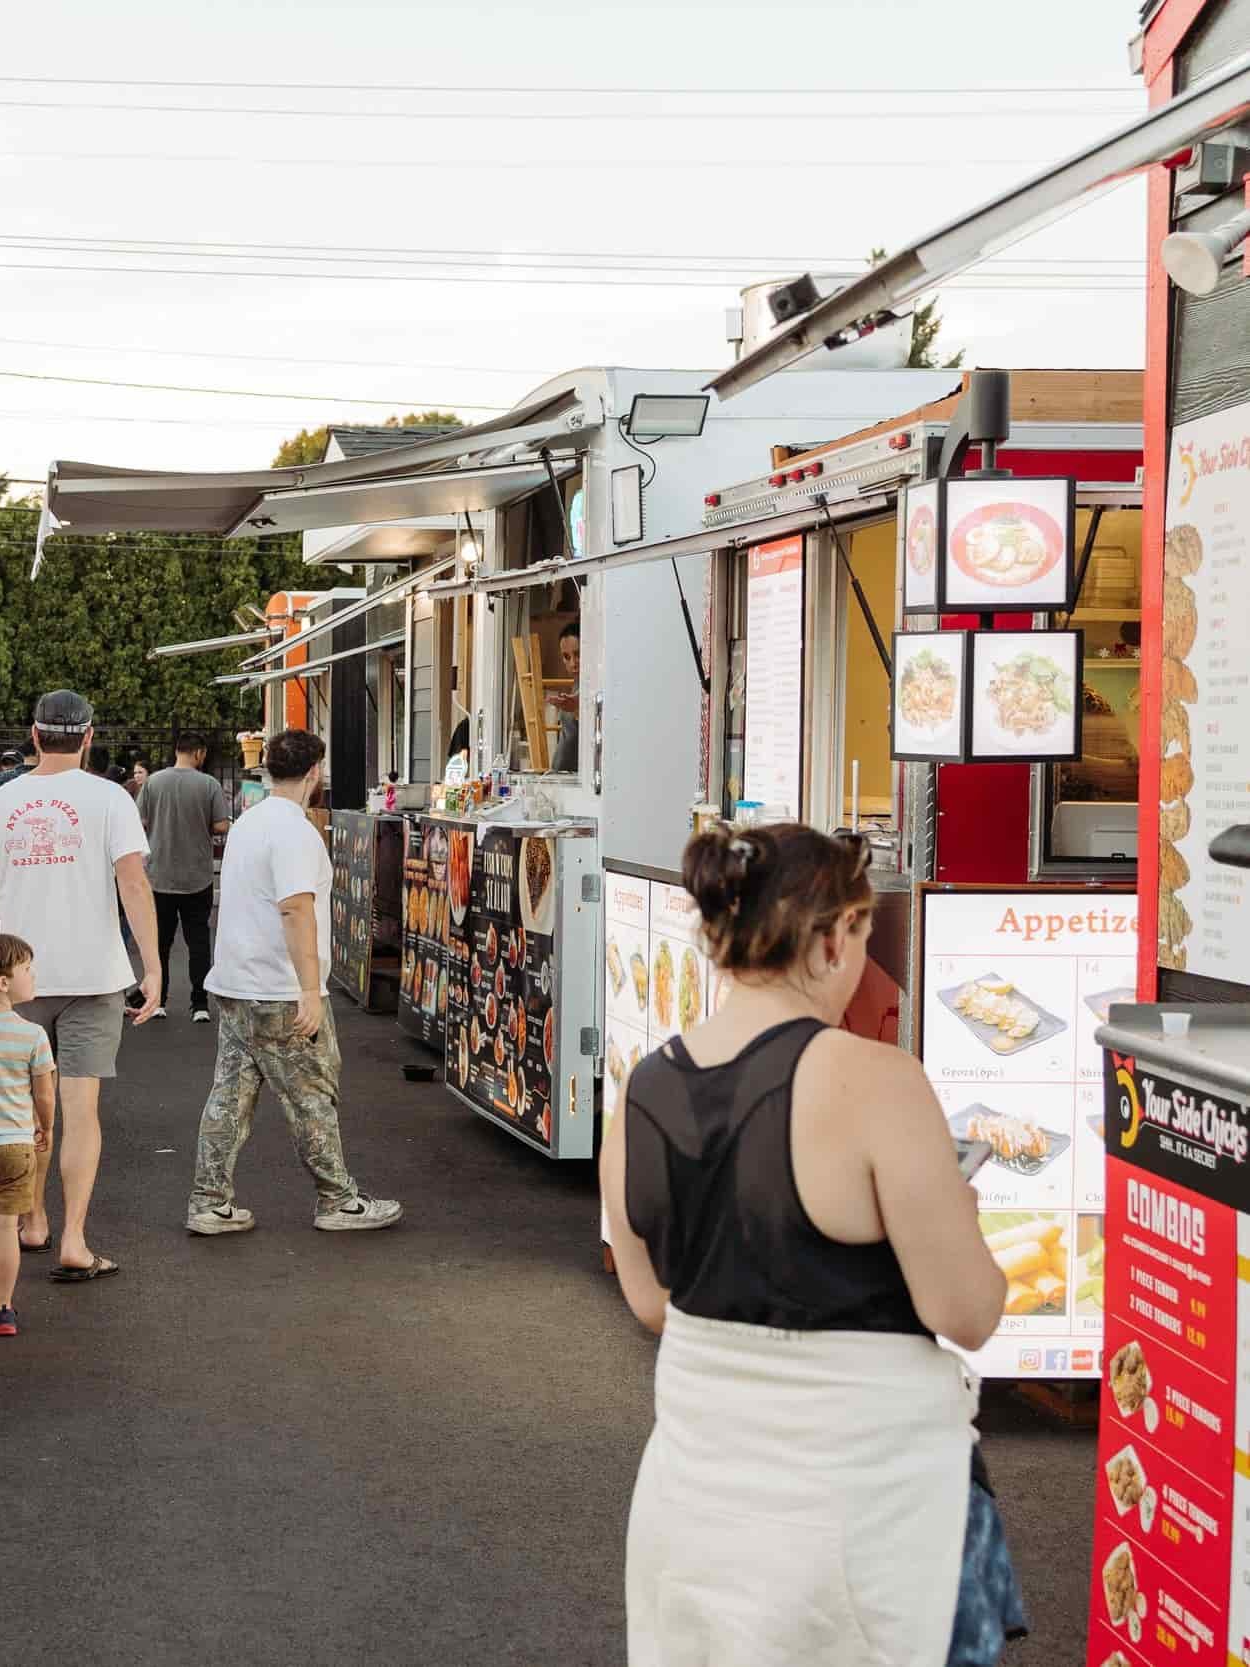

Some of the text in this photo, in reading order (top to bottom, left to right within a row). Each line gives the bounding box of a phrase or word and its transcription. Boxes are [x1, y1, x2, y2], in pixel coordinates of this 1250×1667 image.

[6, 800, 78, 831] ATLAS PIZZA
[1142, 1078, 1248, 1165] Your Side Chicks
[1193, 1147, 1217, 1169] SECRET
[1127, 1178, 1205, 1257] COMBOS
[1136, 1268, 1154, 1291] PIECE
